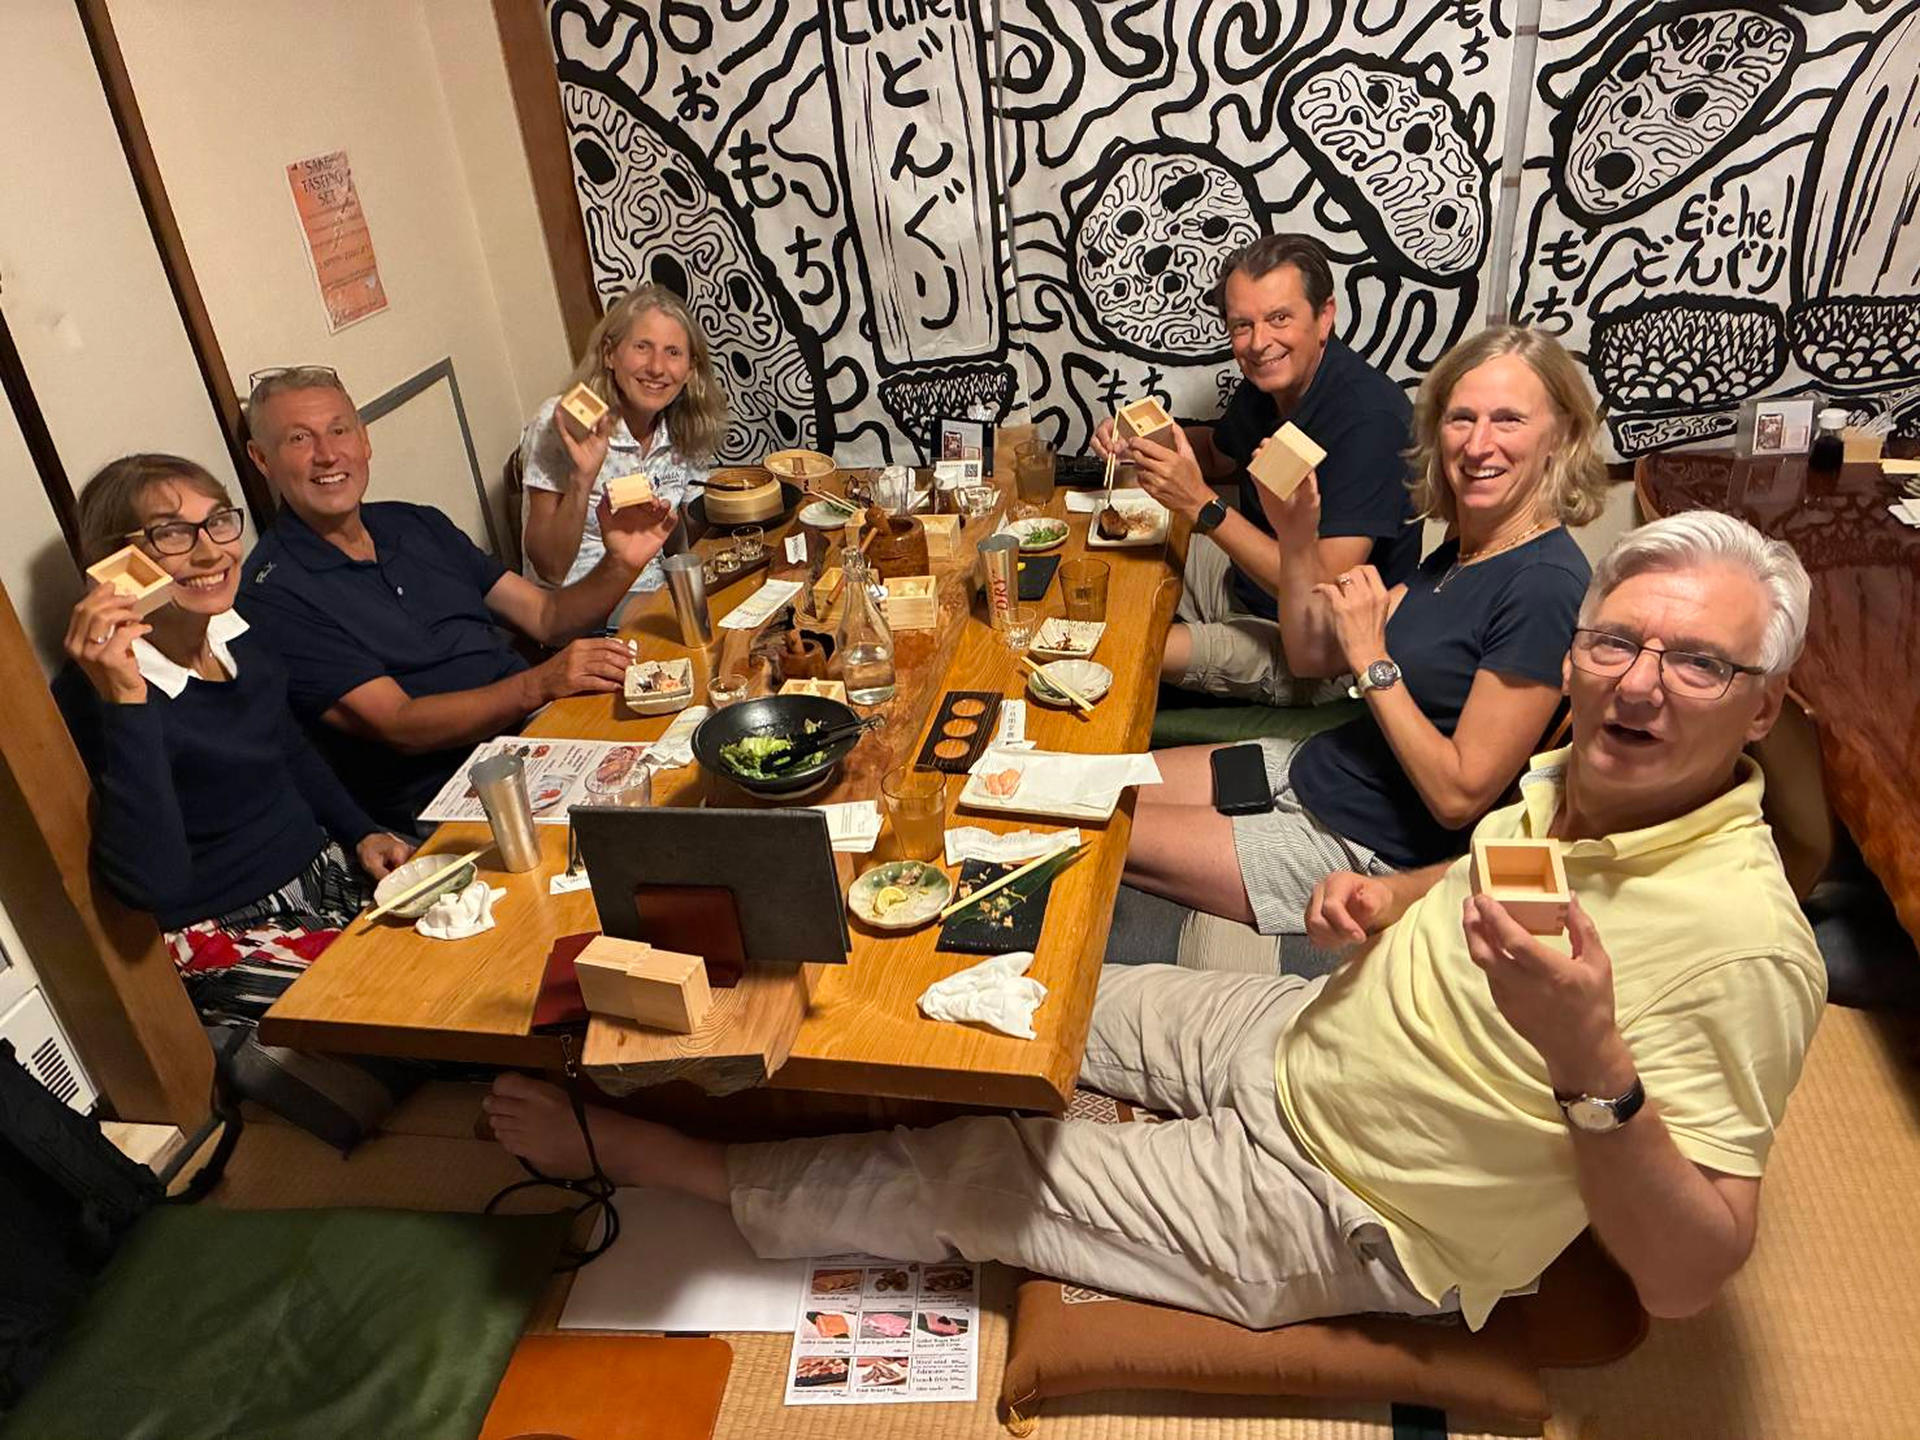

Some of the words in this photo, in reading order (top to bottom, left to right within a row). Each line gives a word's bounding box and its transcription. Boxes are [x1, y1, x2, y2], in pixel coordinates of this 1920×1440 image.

[301, 169, 343, 193] TASTING
[318, 189, 336, 207] SET
[876, 26, 966, 330] どんぐり
[1676, 174, 1794, 242] Eichel
[1533, 230, 1587, 337] もち
[1632, 235, 1787, 294] どんぐり
